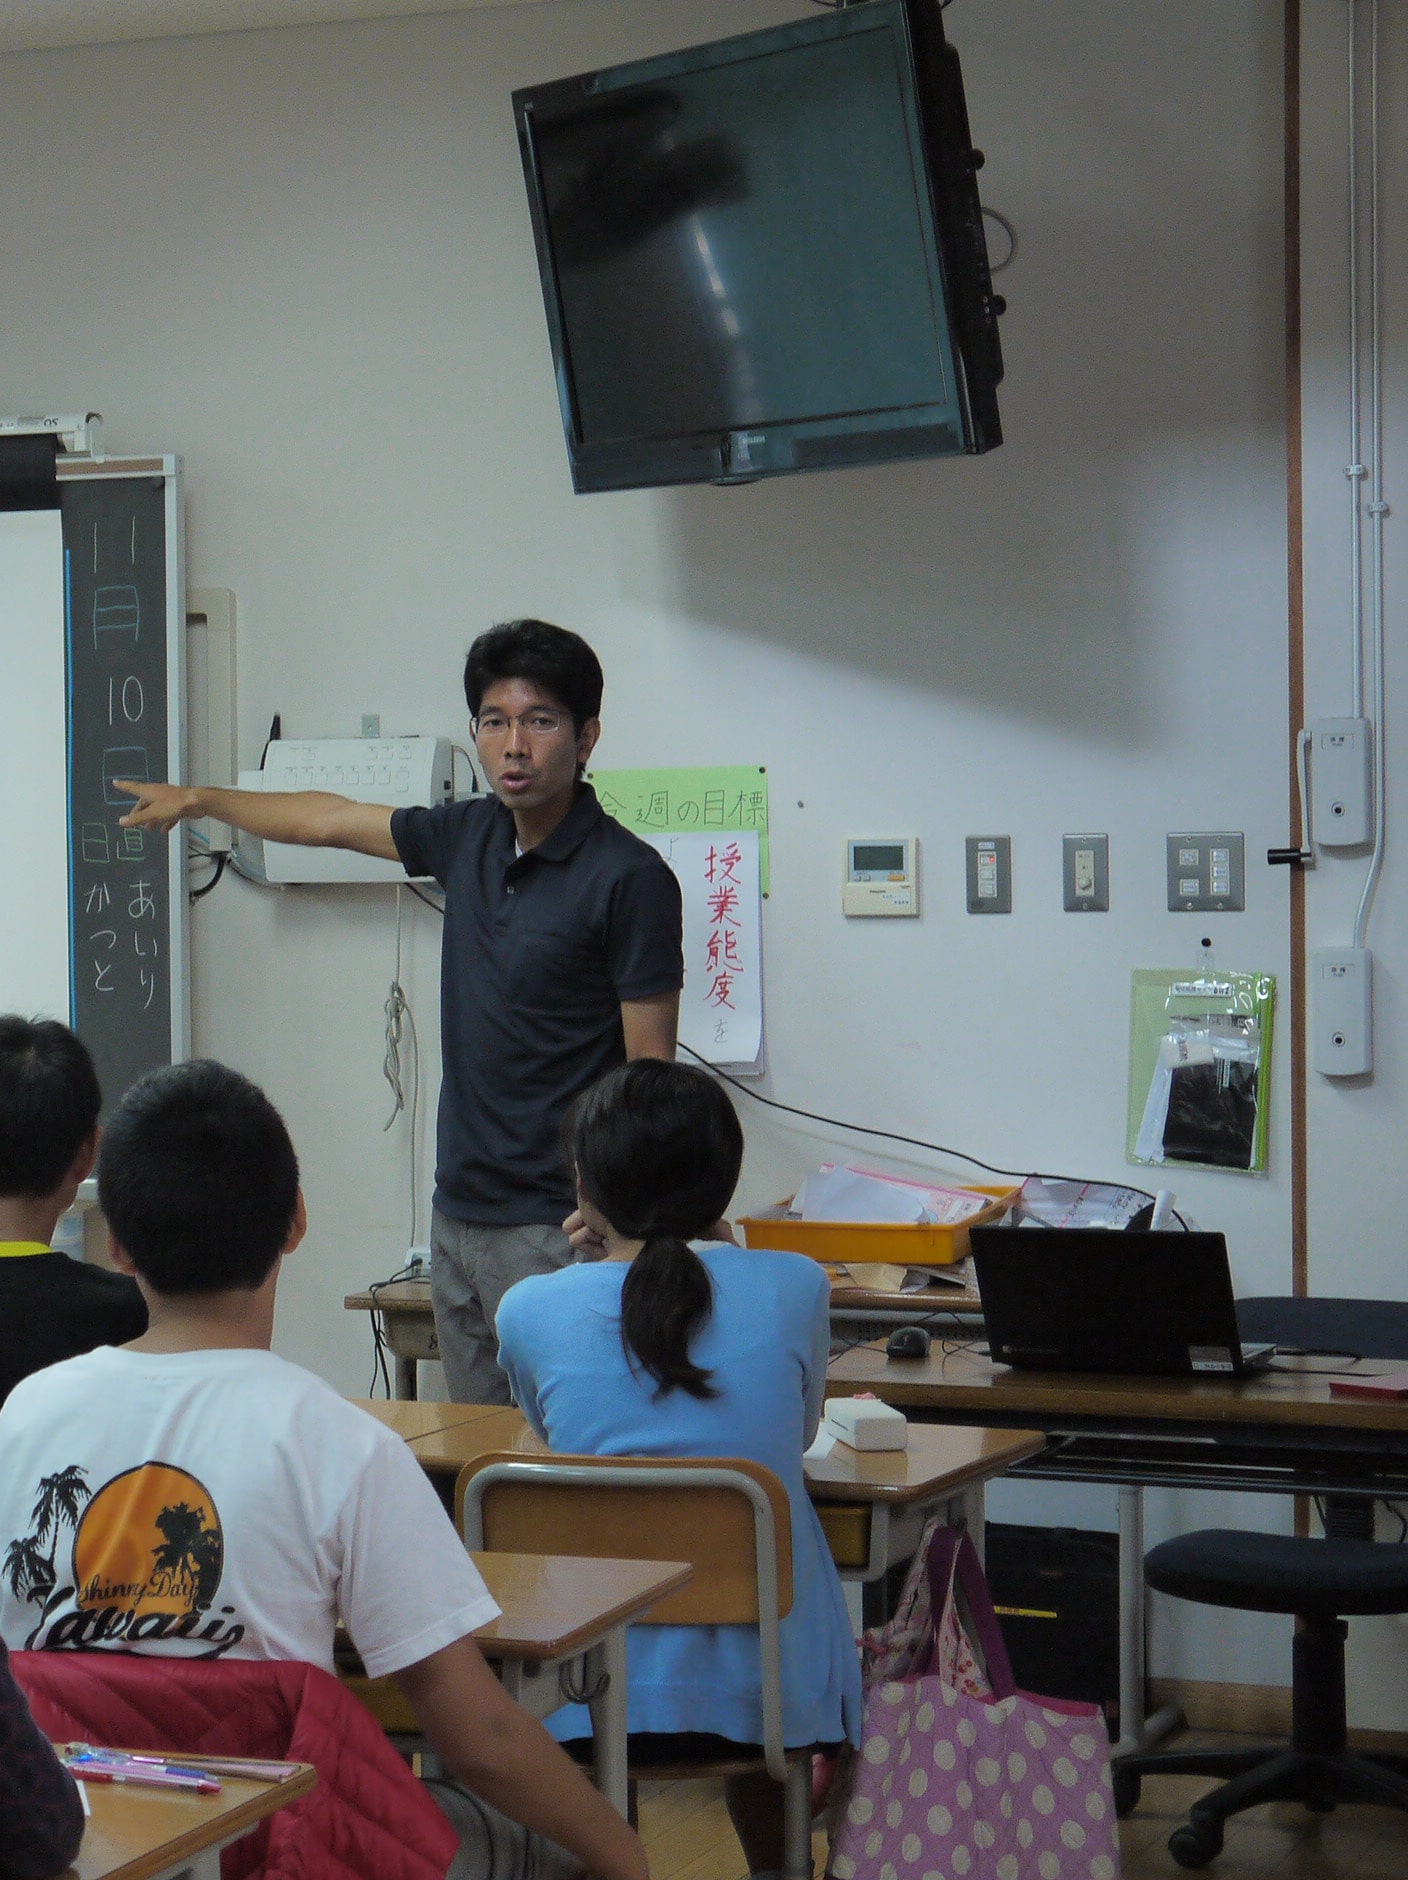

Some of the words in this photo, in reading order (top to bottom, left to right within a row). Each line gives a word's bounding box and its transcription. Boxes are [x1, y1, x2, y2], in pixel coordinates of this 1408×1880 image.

[598, 789, 765, 828] 今週の目標
